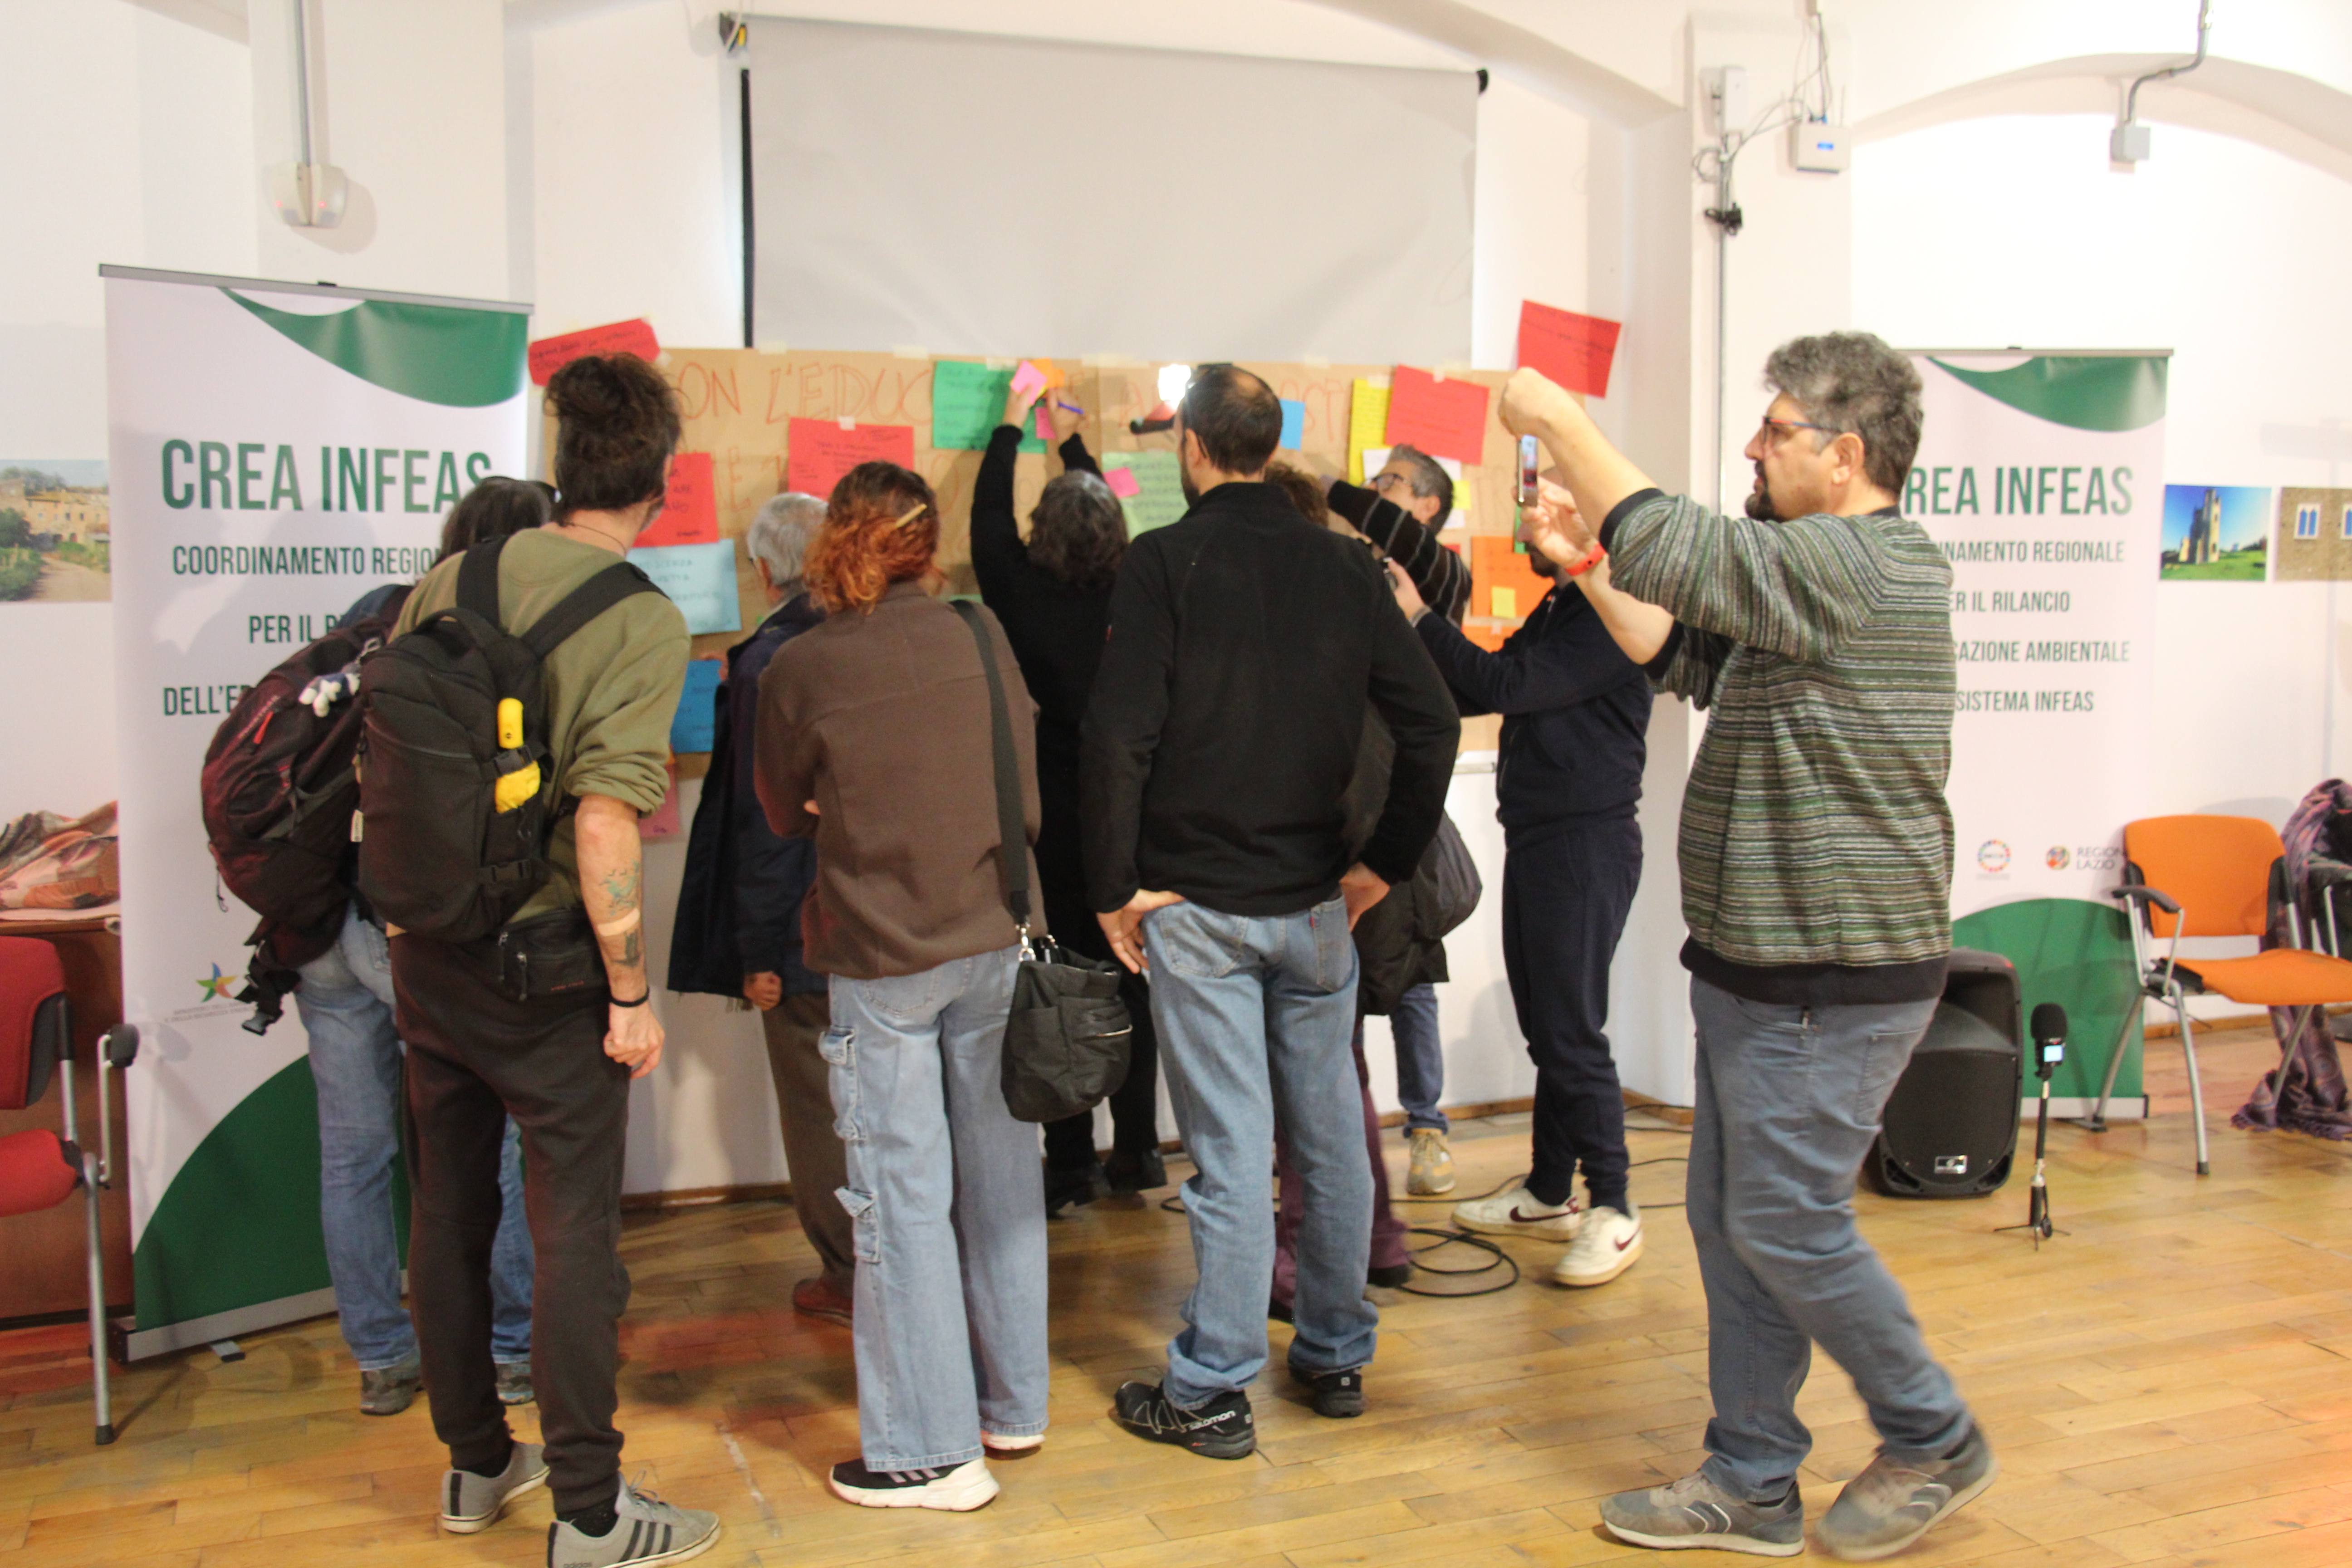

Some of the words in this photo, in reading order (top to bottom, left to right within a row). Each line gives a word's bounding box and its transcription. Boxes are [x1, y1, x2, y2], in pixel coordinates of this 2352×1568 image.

[678, 362, 742, 420] ON
[765, 362, 931, 426] L'EDUC
[162, 439, 304, 510] CREA
[1905, 466, 1980, 515] REA
[1995, 466, 2133, 515] INFEAS
[172, 545, 365, 575] COORDINAMENTO
[2033, 541, 2125, 562] REGIONALE
[1972, 592, 1987, 612] IL
[1993, 591, 2070, 612] RILANCIO
[249, 615, 291, 644] PER
[299, 614, 318, 642] IL
[2025, 641, 2131, 662] AMBIENTALE
[163, 684, 251, 716] DELL'E
[1956, 691, 2029, 712] SISTEMA
[2035, 691, 2094, 712] INFEAS
[2077, 859, 2115, 870] LAZIO
